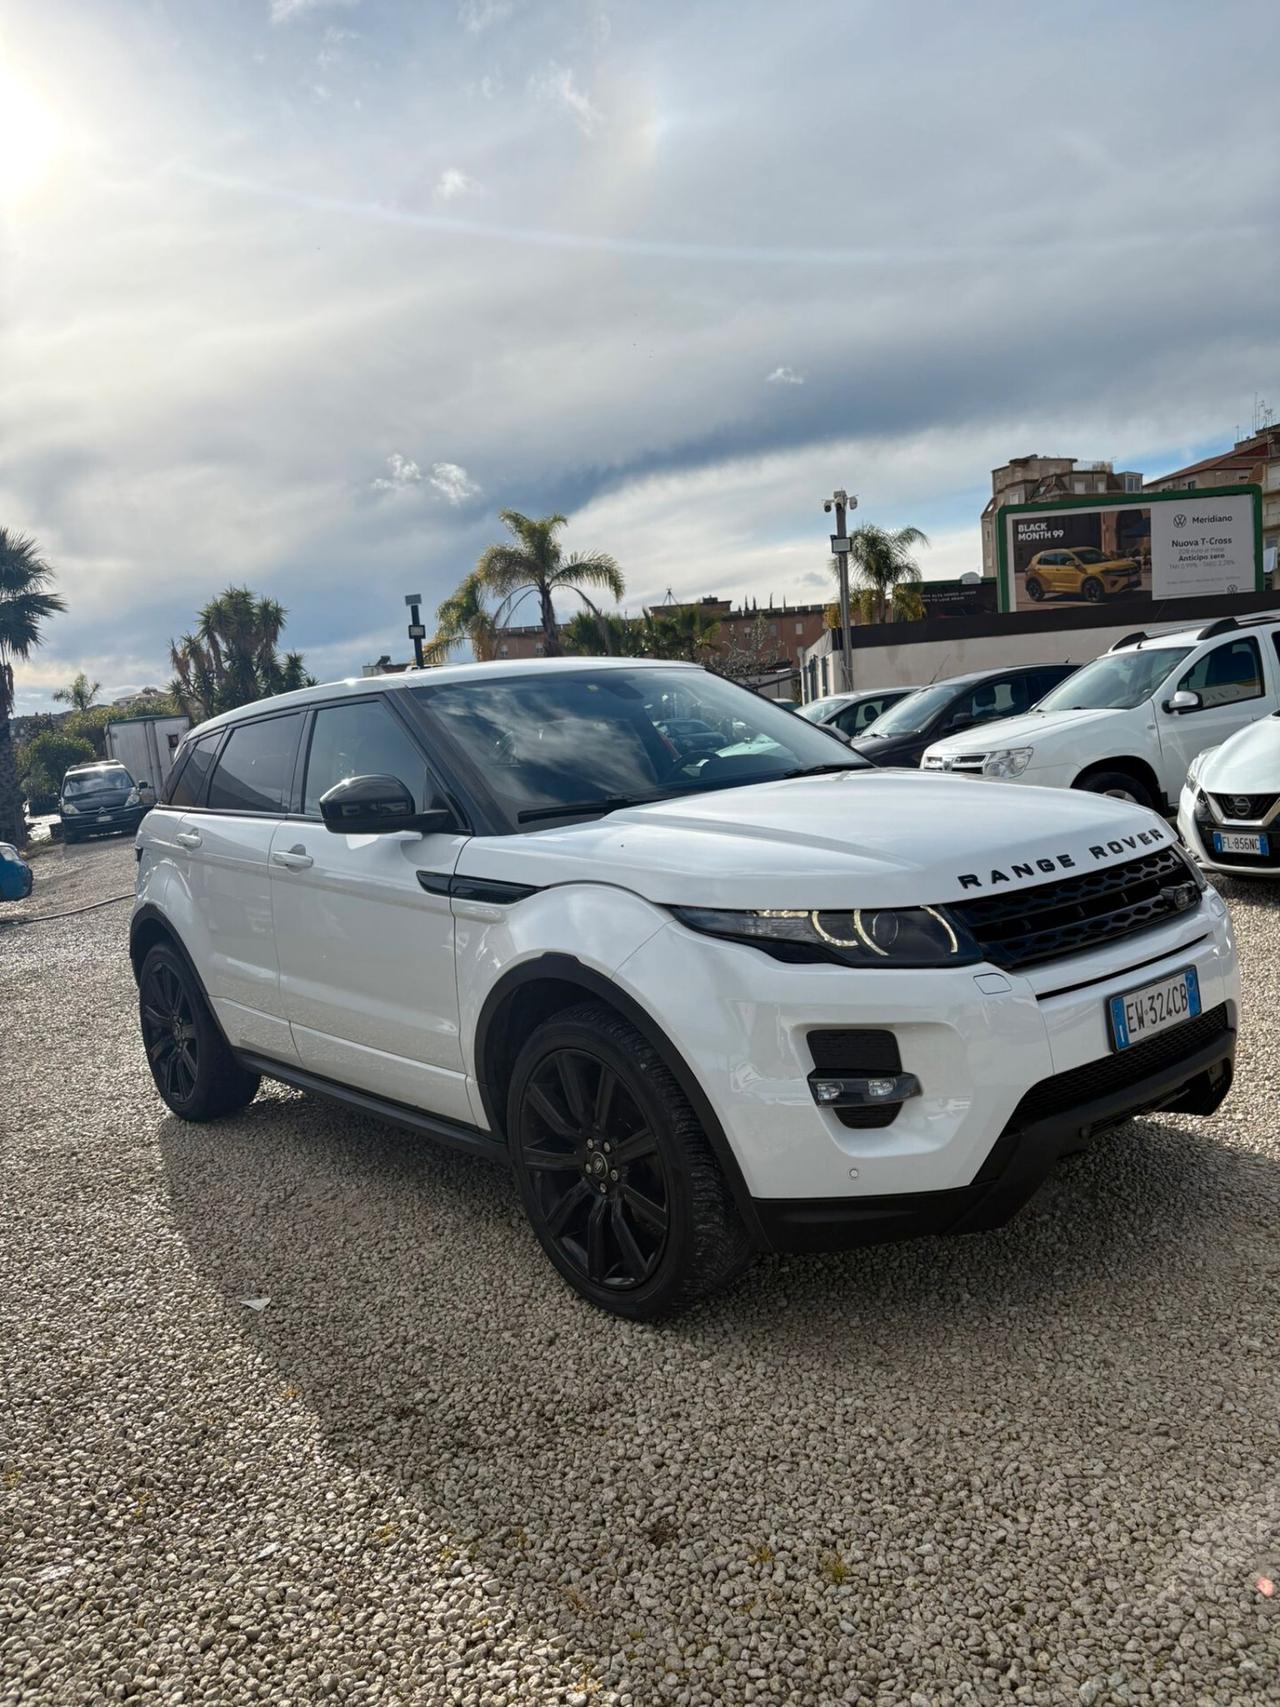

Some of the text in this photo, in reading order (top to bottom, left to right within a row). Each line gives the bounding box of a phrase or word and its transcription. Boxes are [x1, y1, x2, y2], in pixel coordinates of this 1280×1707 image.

[1192, 515, 1233, 524] Meridiano
[1018, 522, 1047, 532] BLACK
[1018, 530, 1064, 541] MONTH 99
[1172, 537, 1232, 547] Nuova T-Cross
[1179, 554, 1208, 562] Anticipo
[957, 828, 1165, 889] RANGE ROVER
